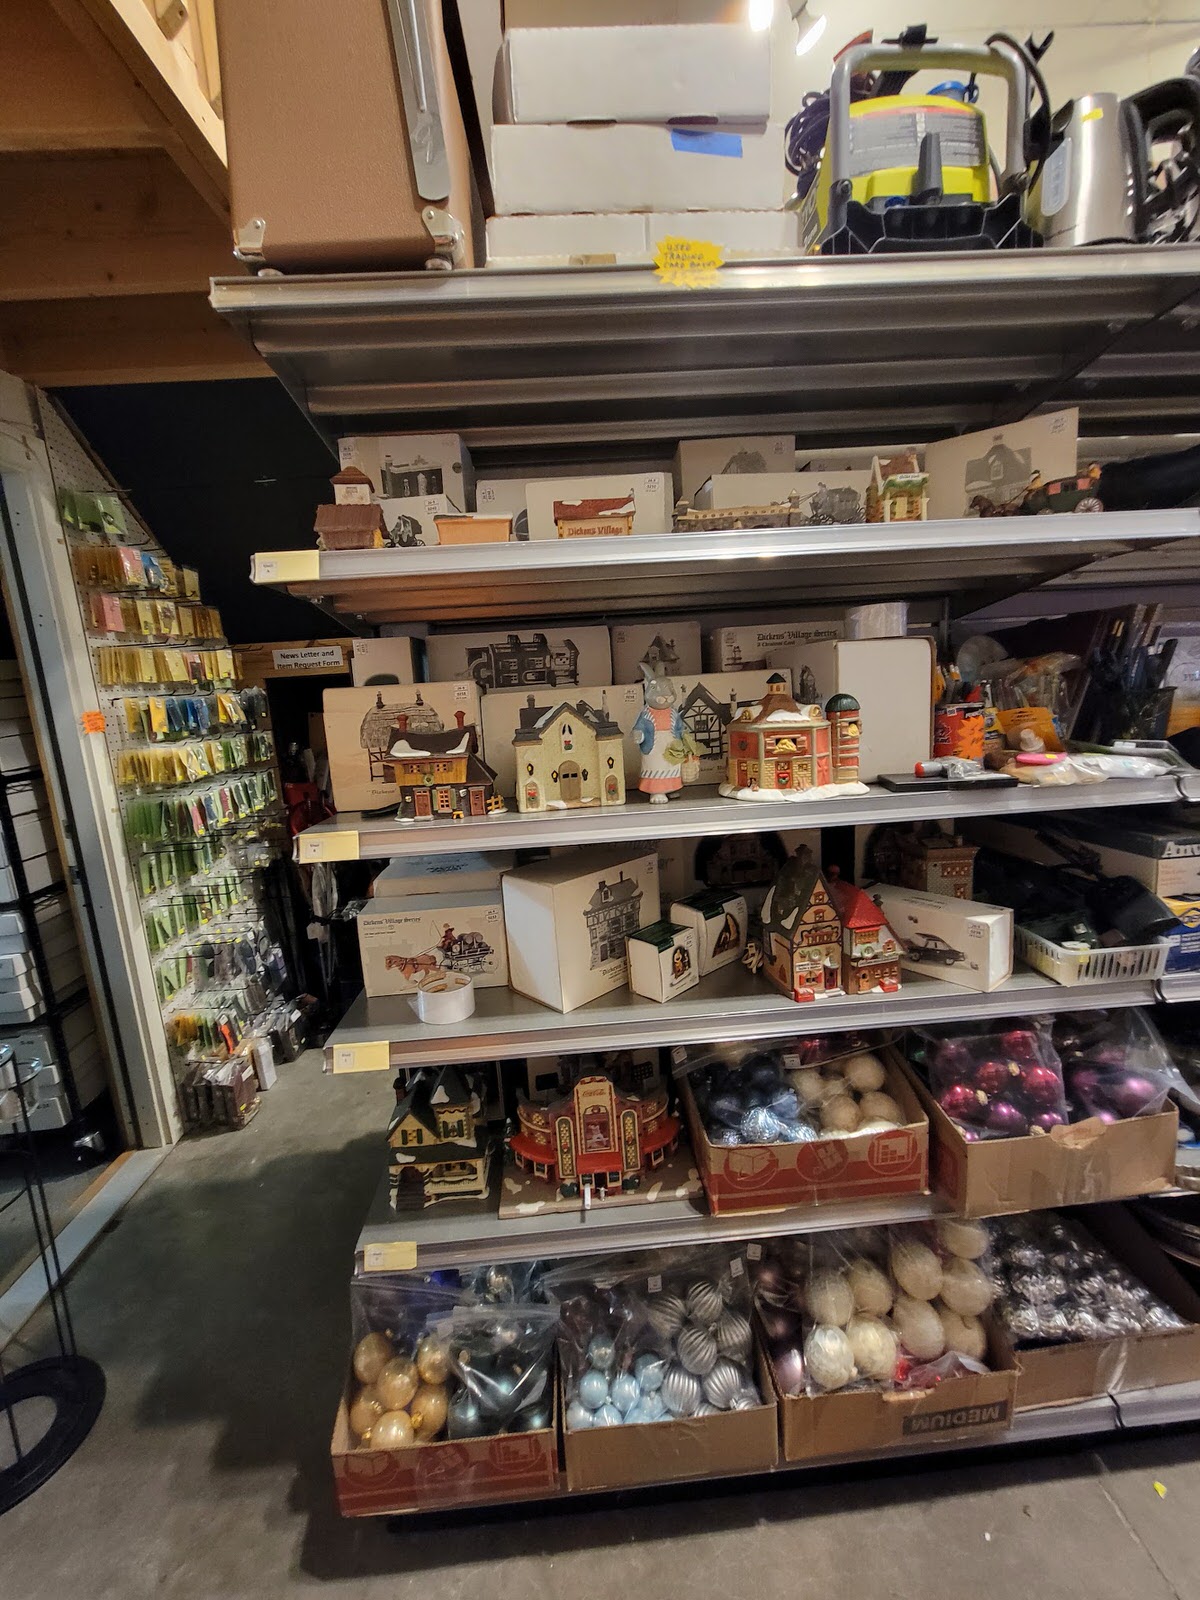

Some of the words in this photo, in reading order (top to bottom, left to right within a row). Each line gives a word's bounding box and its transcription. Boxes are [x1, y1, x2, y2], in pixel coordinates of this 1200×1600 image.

[596, 525, 624, 535] Village
[786, 630, 812, 641] Village
[813, 629, 838, 638] Series
[300, 651, 320, 659] Letter
[321, 649, 335, 657] and
[293, 660, 322, 669] Request
[322, 659, 341, 667] Form
[910, 1405, 1001, 1432] MEDIUM
